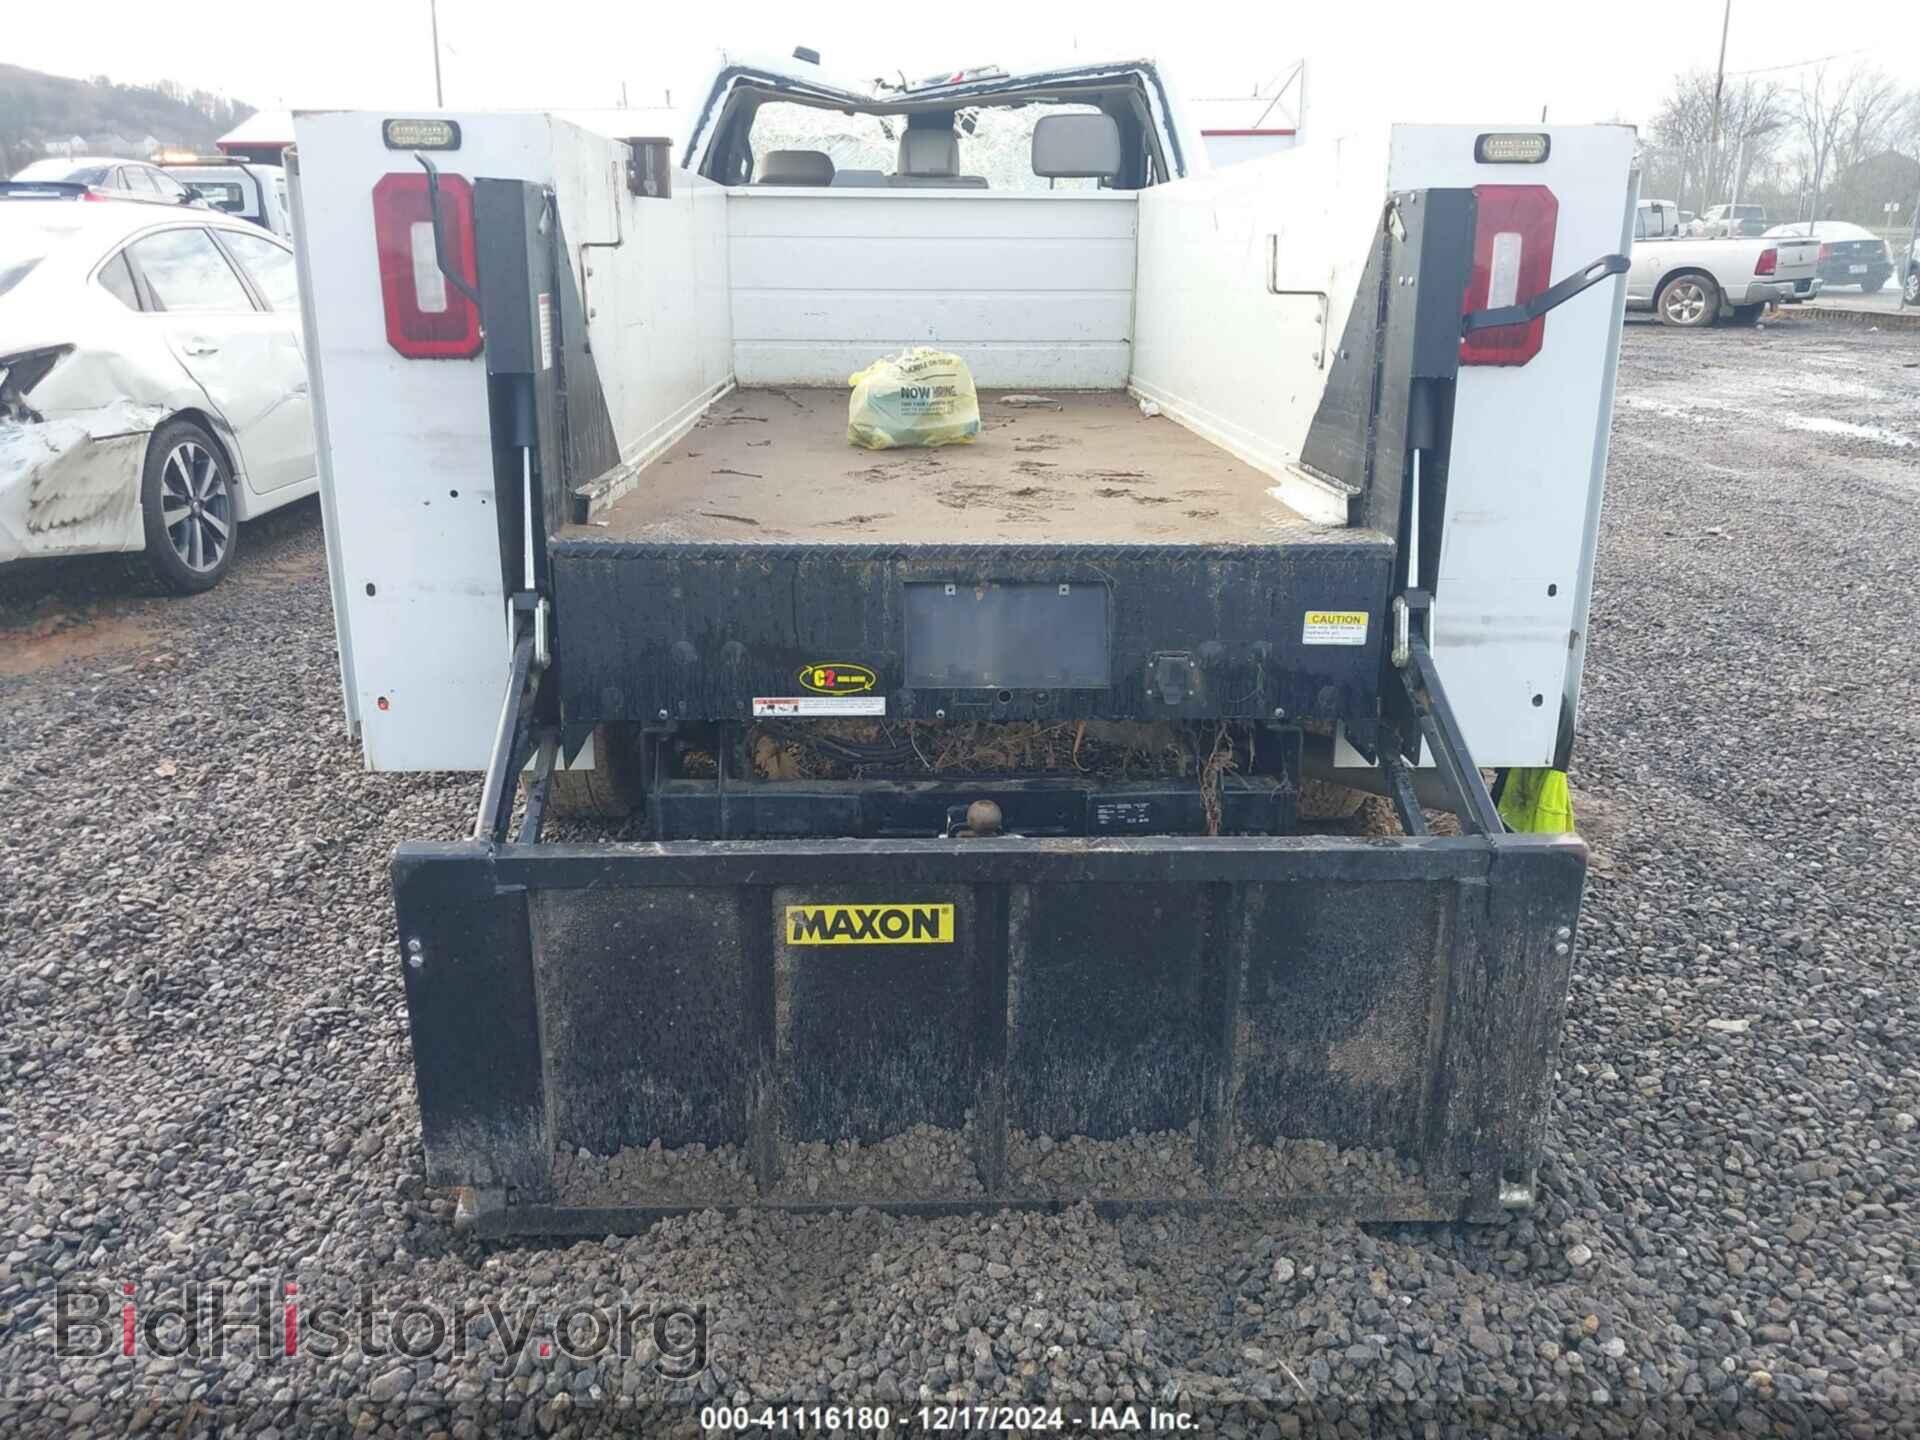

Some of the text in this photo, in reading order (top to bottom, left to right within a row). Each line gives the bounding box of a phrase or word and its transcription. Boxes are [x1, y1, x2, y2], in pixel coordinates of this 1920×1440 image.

[901, 387, 930, 399] NOW
[1312, 615, 1361, 624] CAUTION
[814, 669, 835, 687] C2
[793, 909, 940, 940] MAXON
